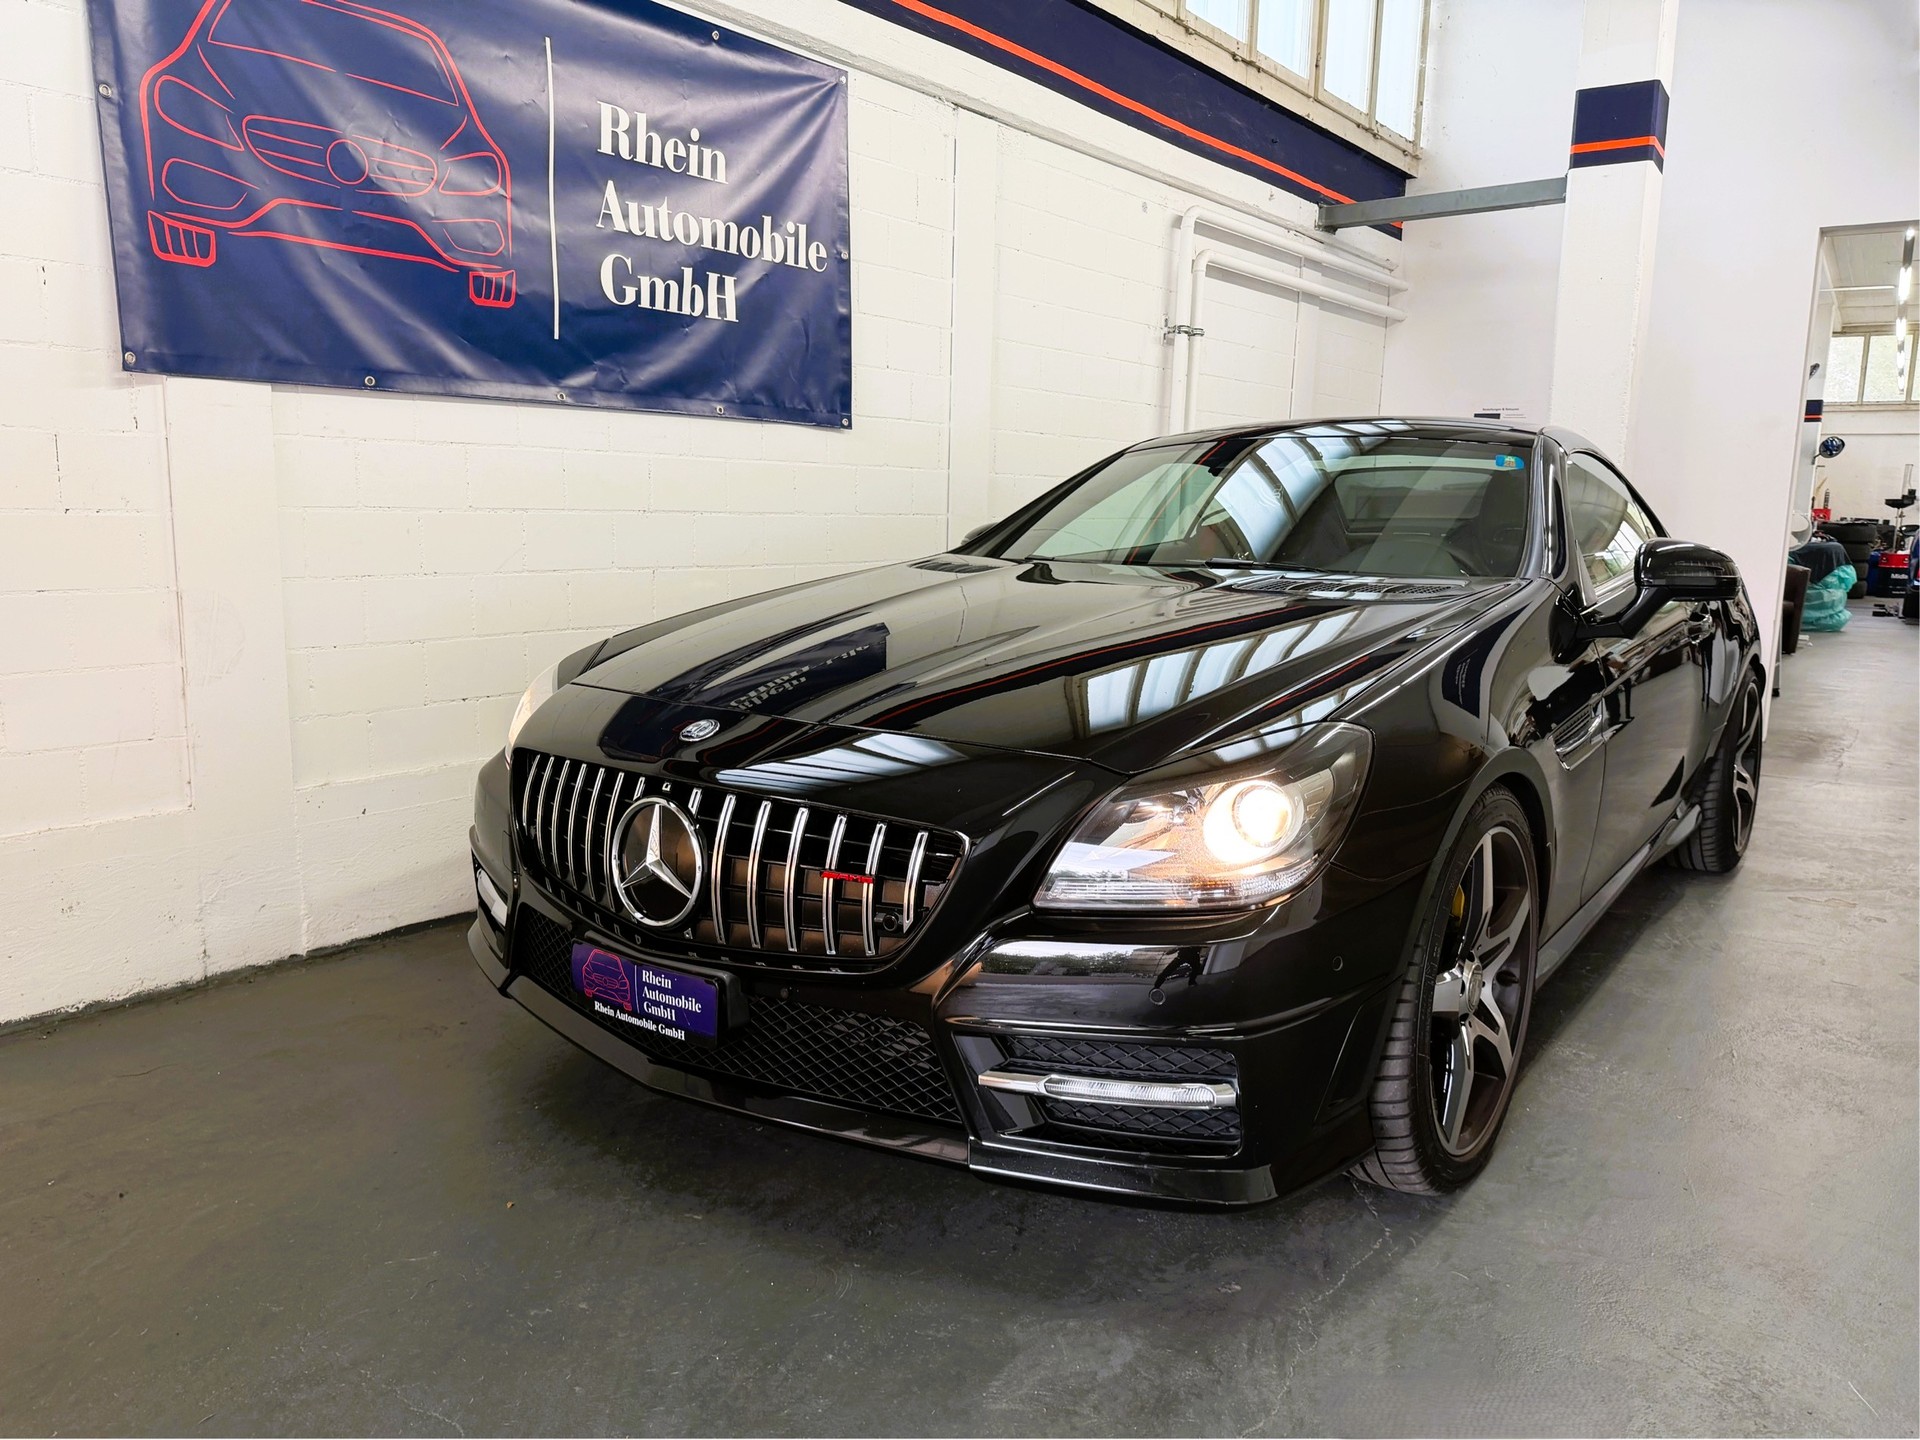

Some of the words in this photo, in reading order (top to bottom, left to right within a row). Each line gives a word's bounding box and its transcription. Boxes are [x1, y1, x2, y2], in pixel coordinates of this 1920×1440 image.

[597, 101, 728, 184] Rhein
[596, 180, 828, 272] Automobile
[600, 254, 739, 322] GmbH
[642, 970, 672, 989] Rhein
[642, 986, 702, 1013] Automobile
[594, 1001, 615, 1018] Rhein
[615, 1008, 657, 1031] Automobile
[658, 1023, 686, 1041] GmbH
[643, 1001, 676, 1021] GmbH
